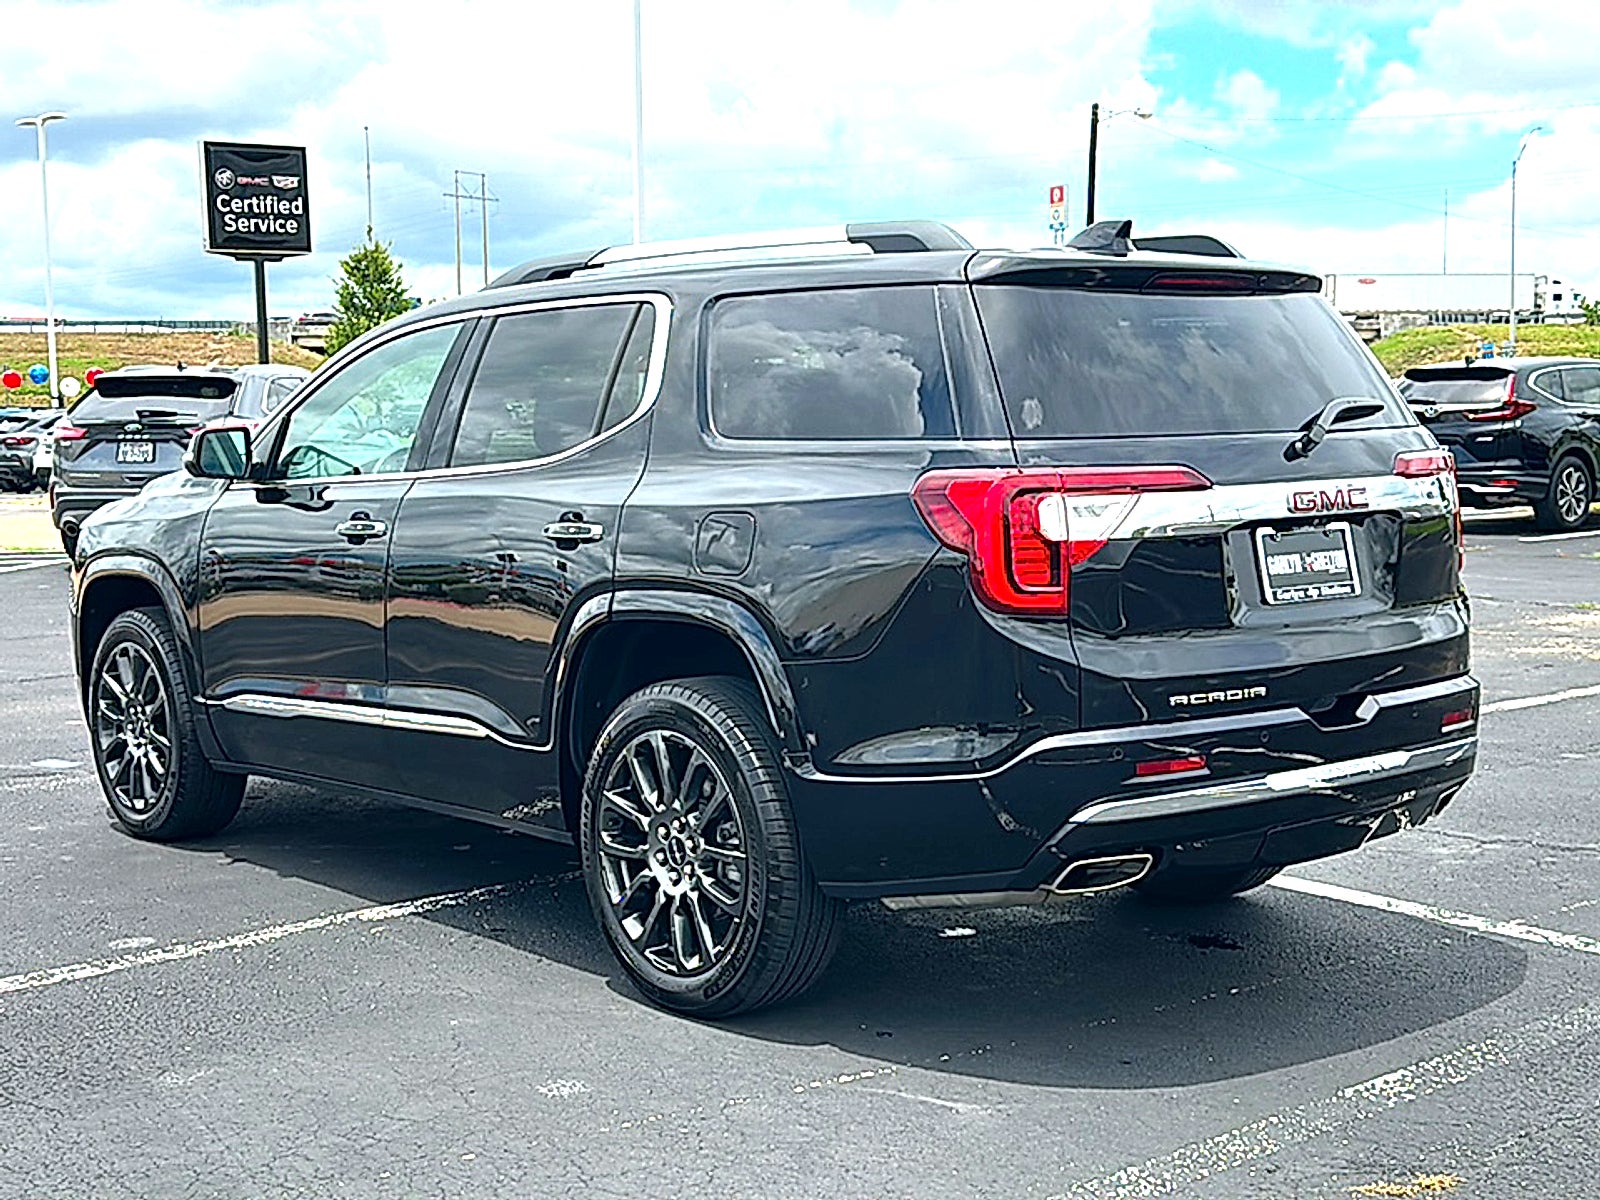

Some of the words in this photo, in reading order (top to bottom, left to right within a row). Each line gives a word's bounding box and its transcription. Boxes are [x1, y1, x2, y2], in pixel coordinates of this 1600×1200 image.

[216, 194, 304, 215] Certified
[223, 213, 299, 234] Service
[1291, 487, 1370, 513] GMC
[1169, 686, 1266, 706] ACADIA
